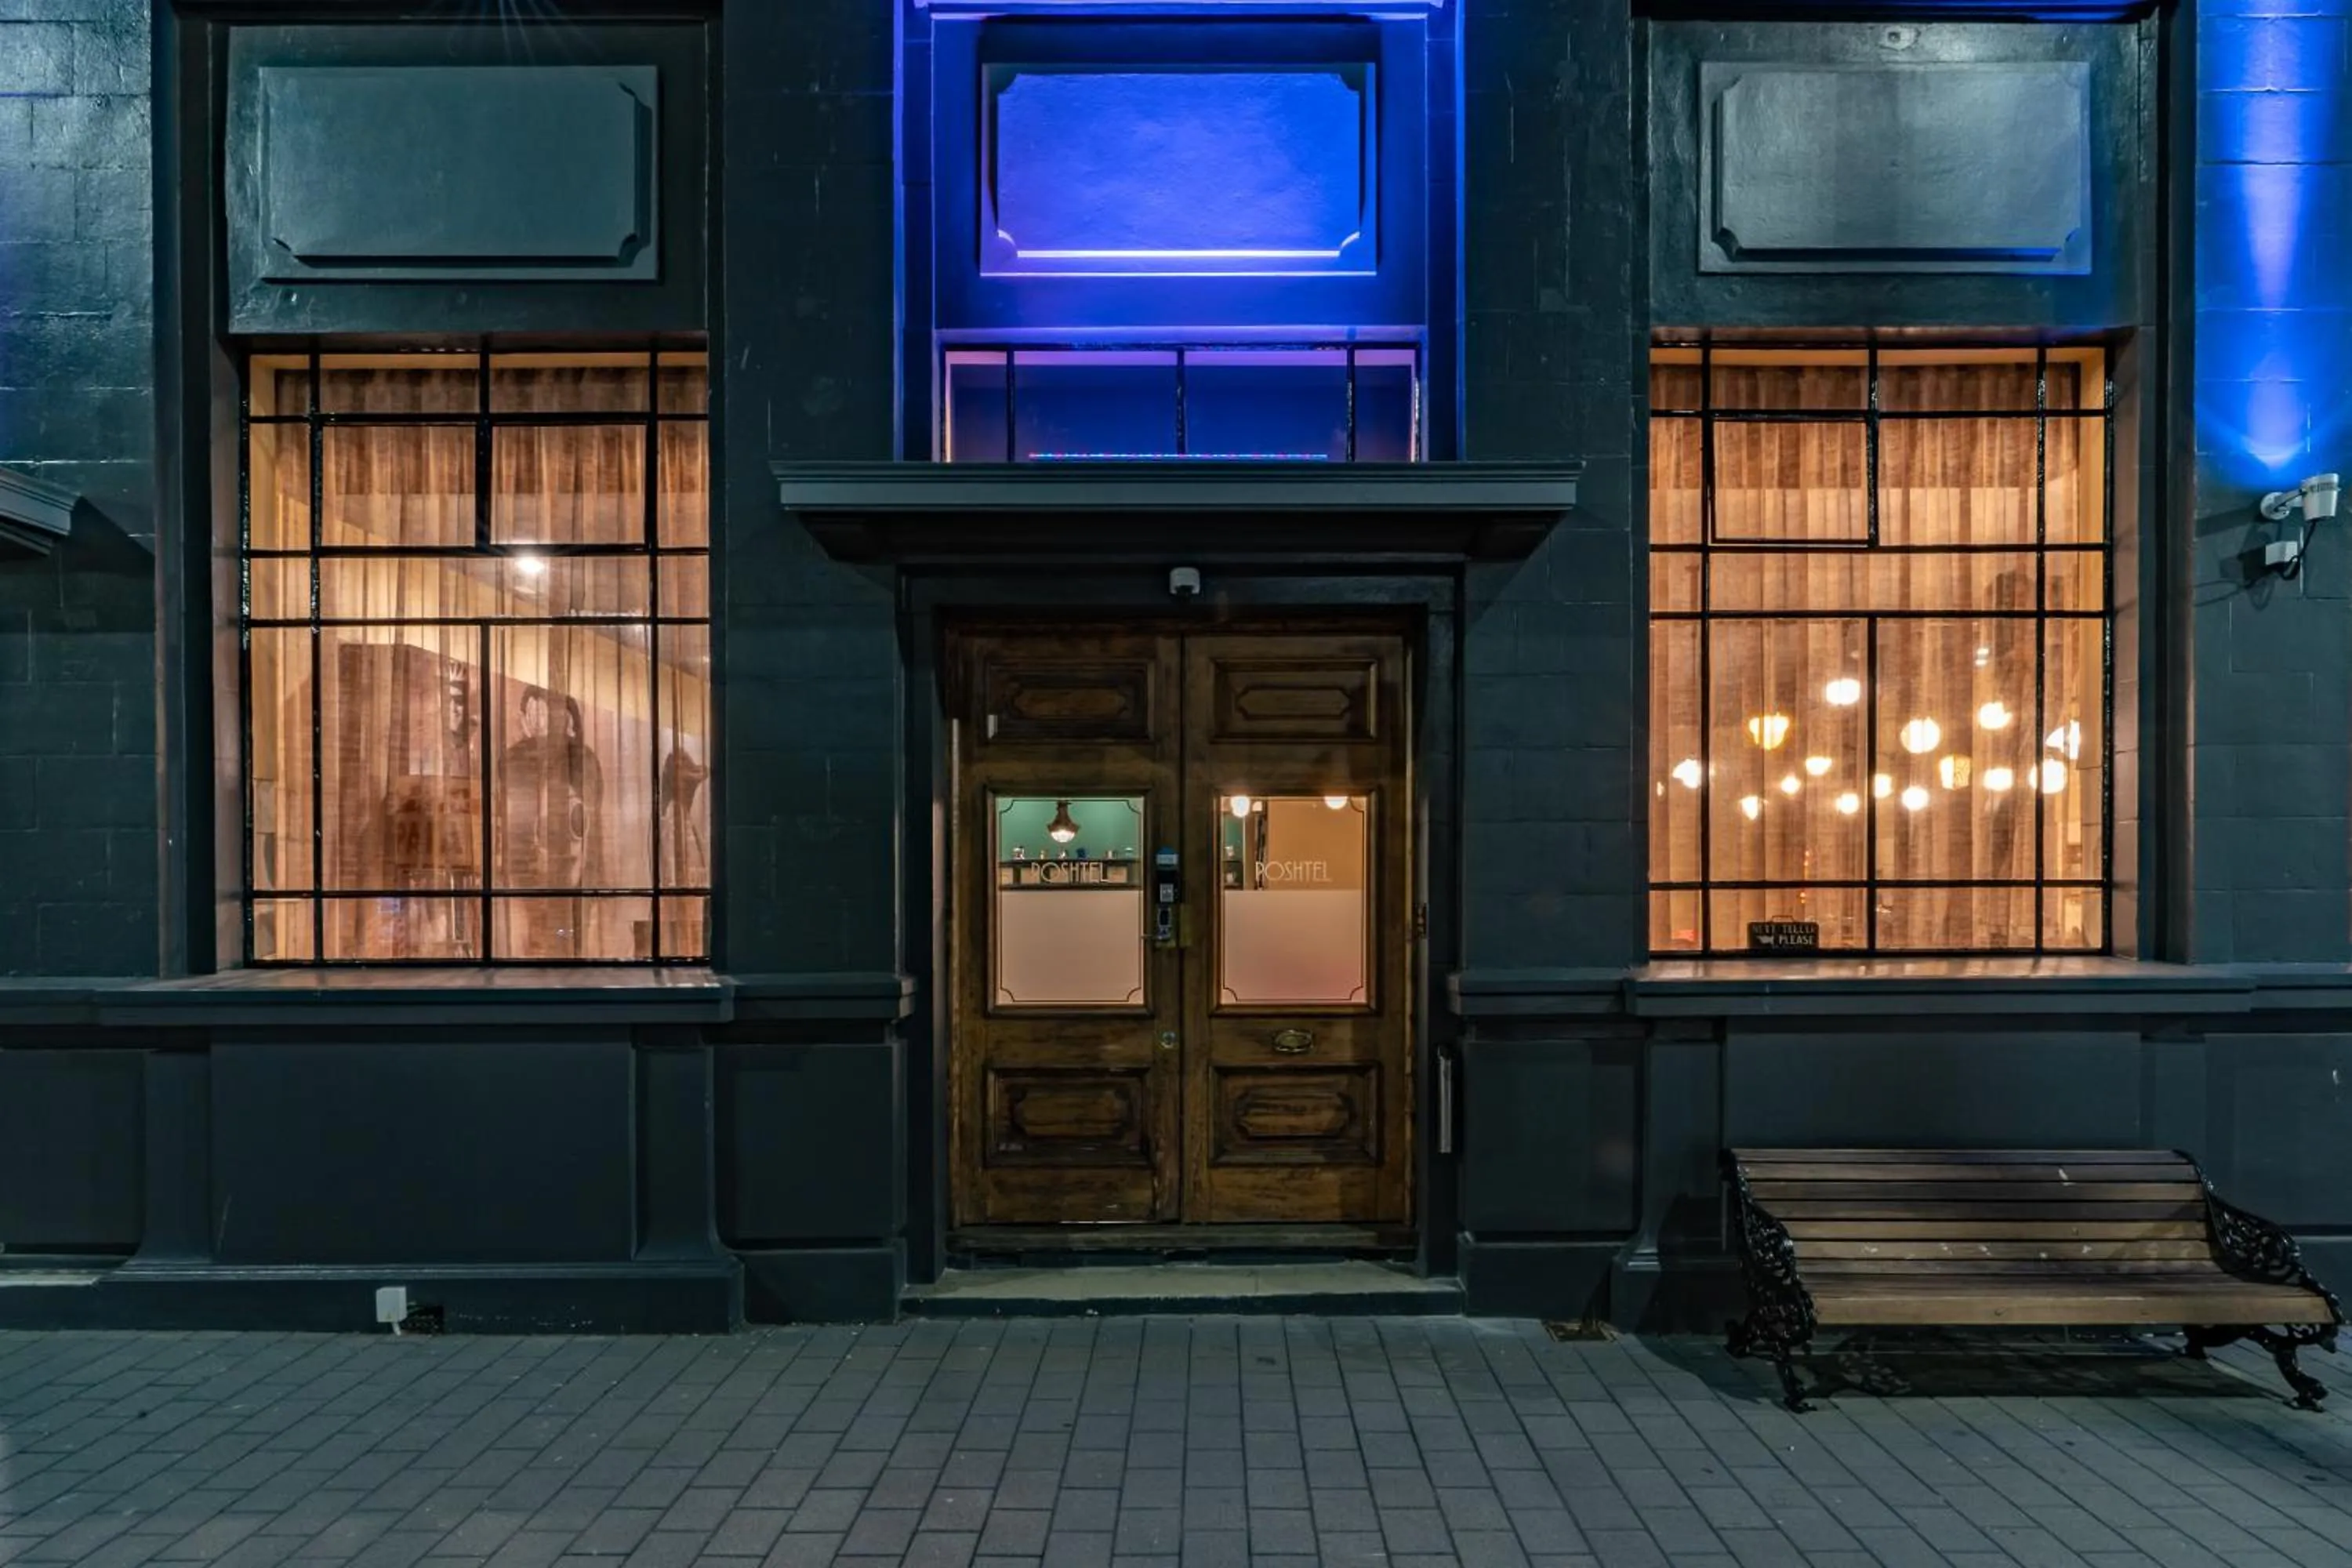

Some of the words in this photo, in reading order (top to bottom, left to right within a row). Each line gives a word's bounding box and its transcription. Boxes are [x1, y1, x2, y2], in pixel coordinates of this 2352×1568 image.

[1030, 861, 1111, 884] POSHTEL
[1255, 860, 1333, 883] POSHTEL
[1778, 934, 1814, 945] PLEASE
